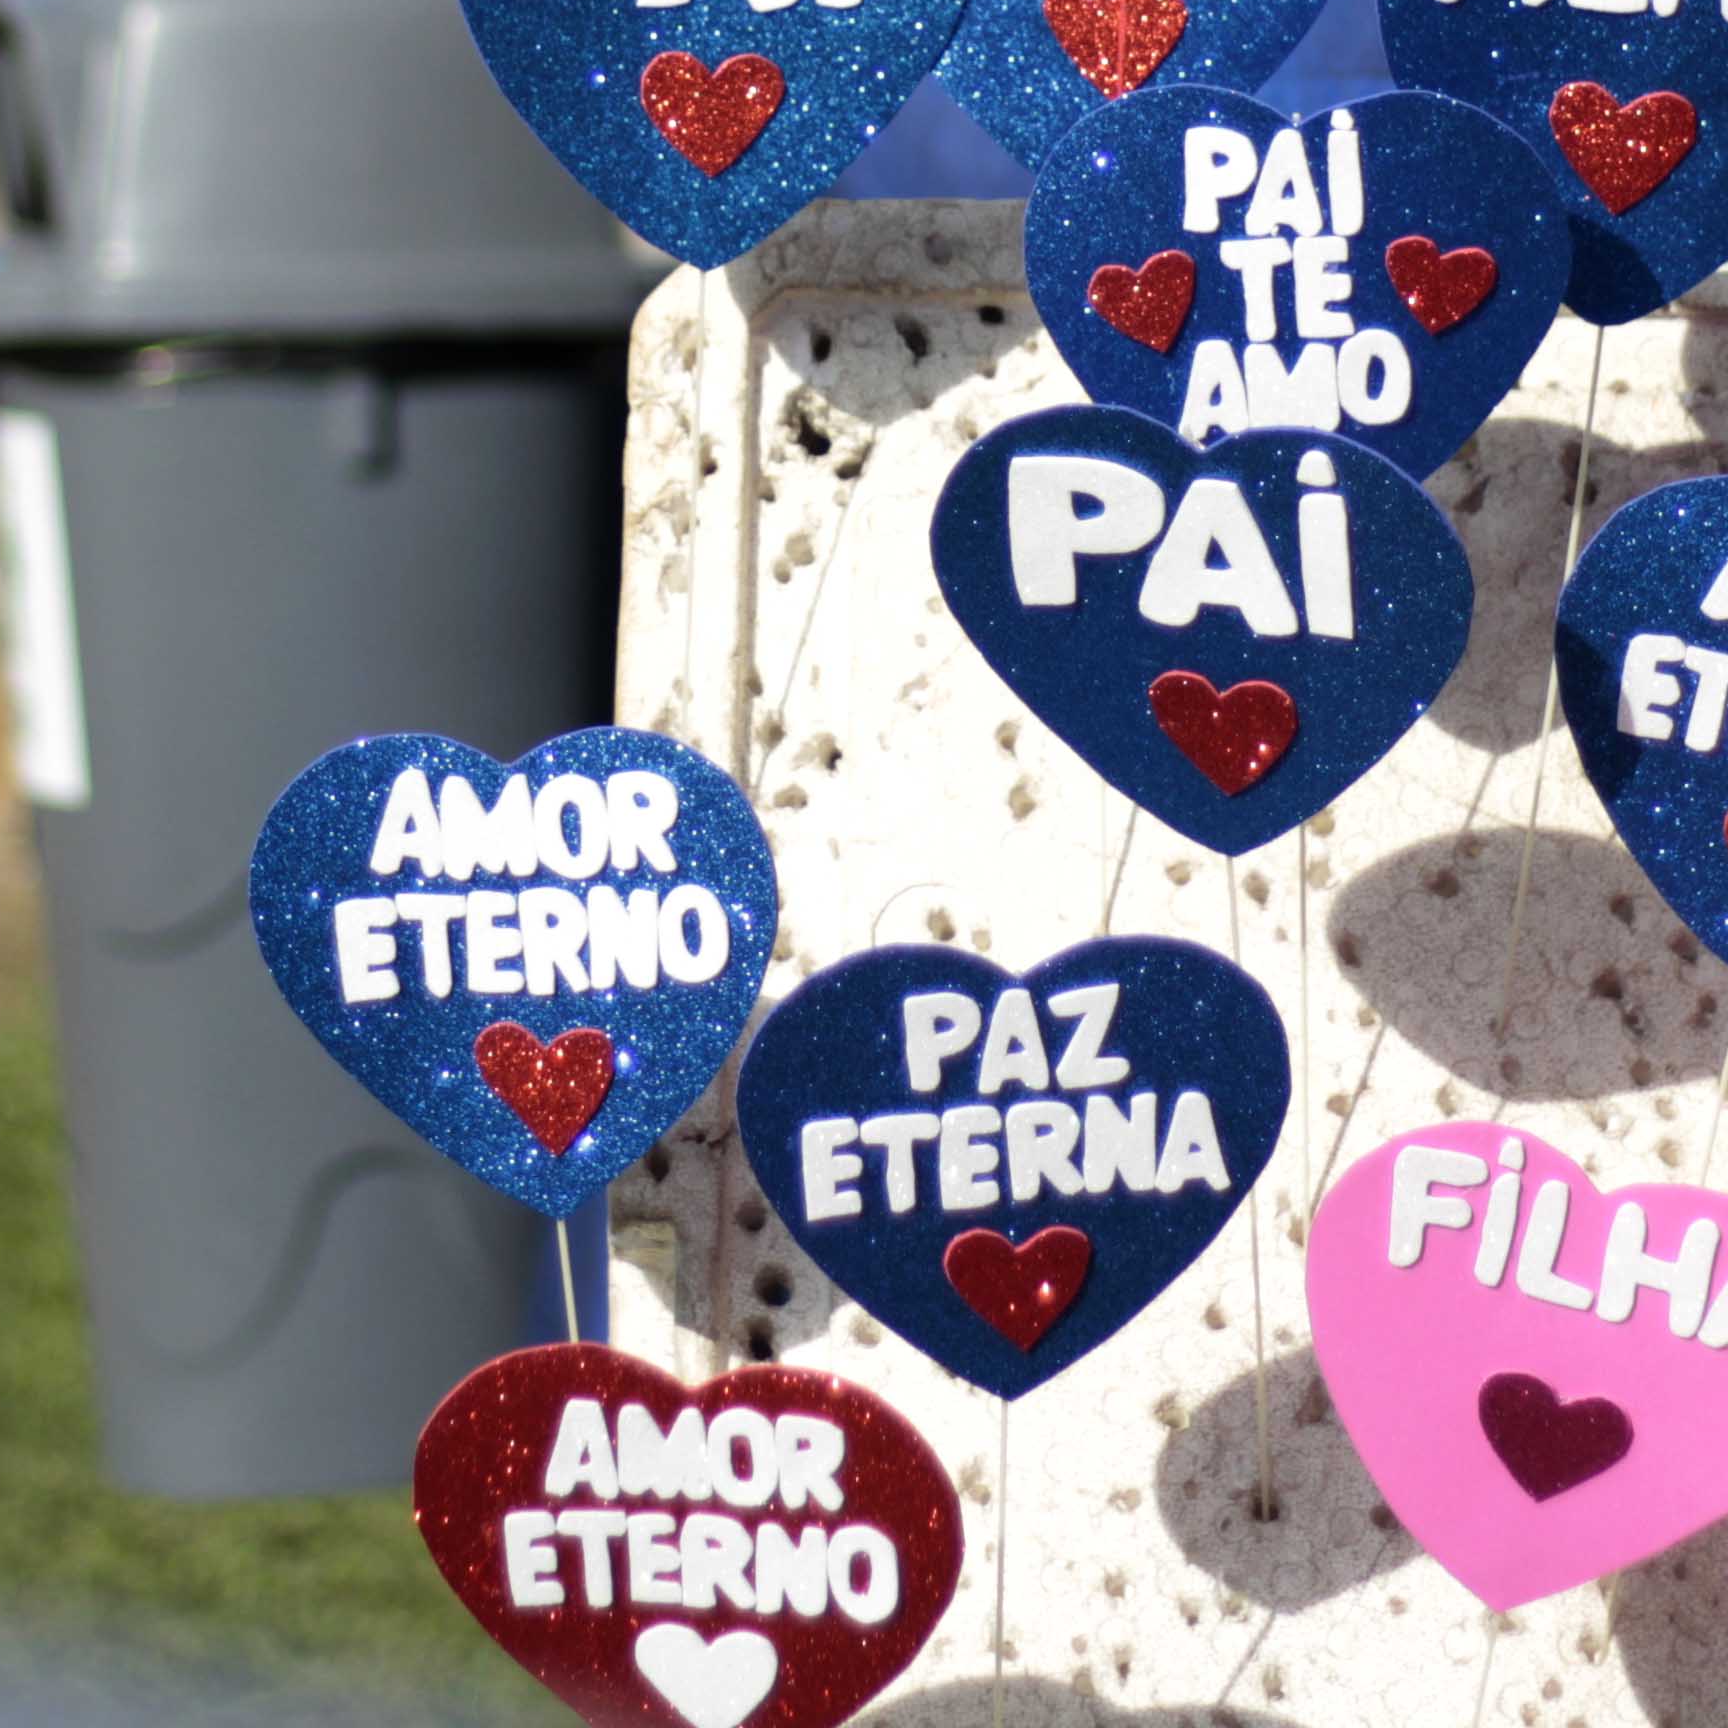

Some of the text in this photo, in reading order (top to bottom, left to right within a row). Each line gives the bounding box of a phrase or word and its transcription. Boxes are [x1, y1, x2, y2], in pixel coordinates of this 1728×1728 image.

[1220, 234, 1355, 342] TE
[1178, 327, 1412, 444] AMO
[369, 767, 679, 880] AMOR
[334, 883, 730, 1004] ETERNO
[902, 983, 1131, 1094] PAZ
[799, 1092, 1232, 1222] ETERNA
[544, 1398, 845, 1511] AMOR
[502, 1510, 900, 1624] ETERNO
